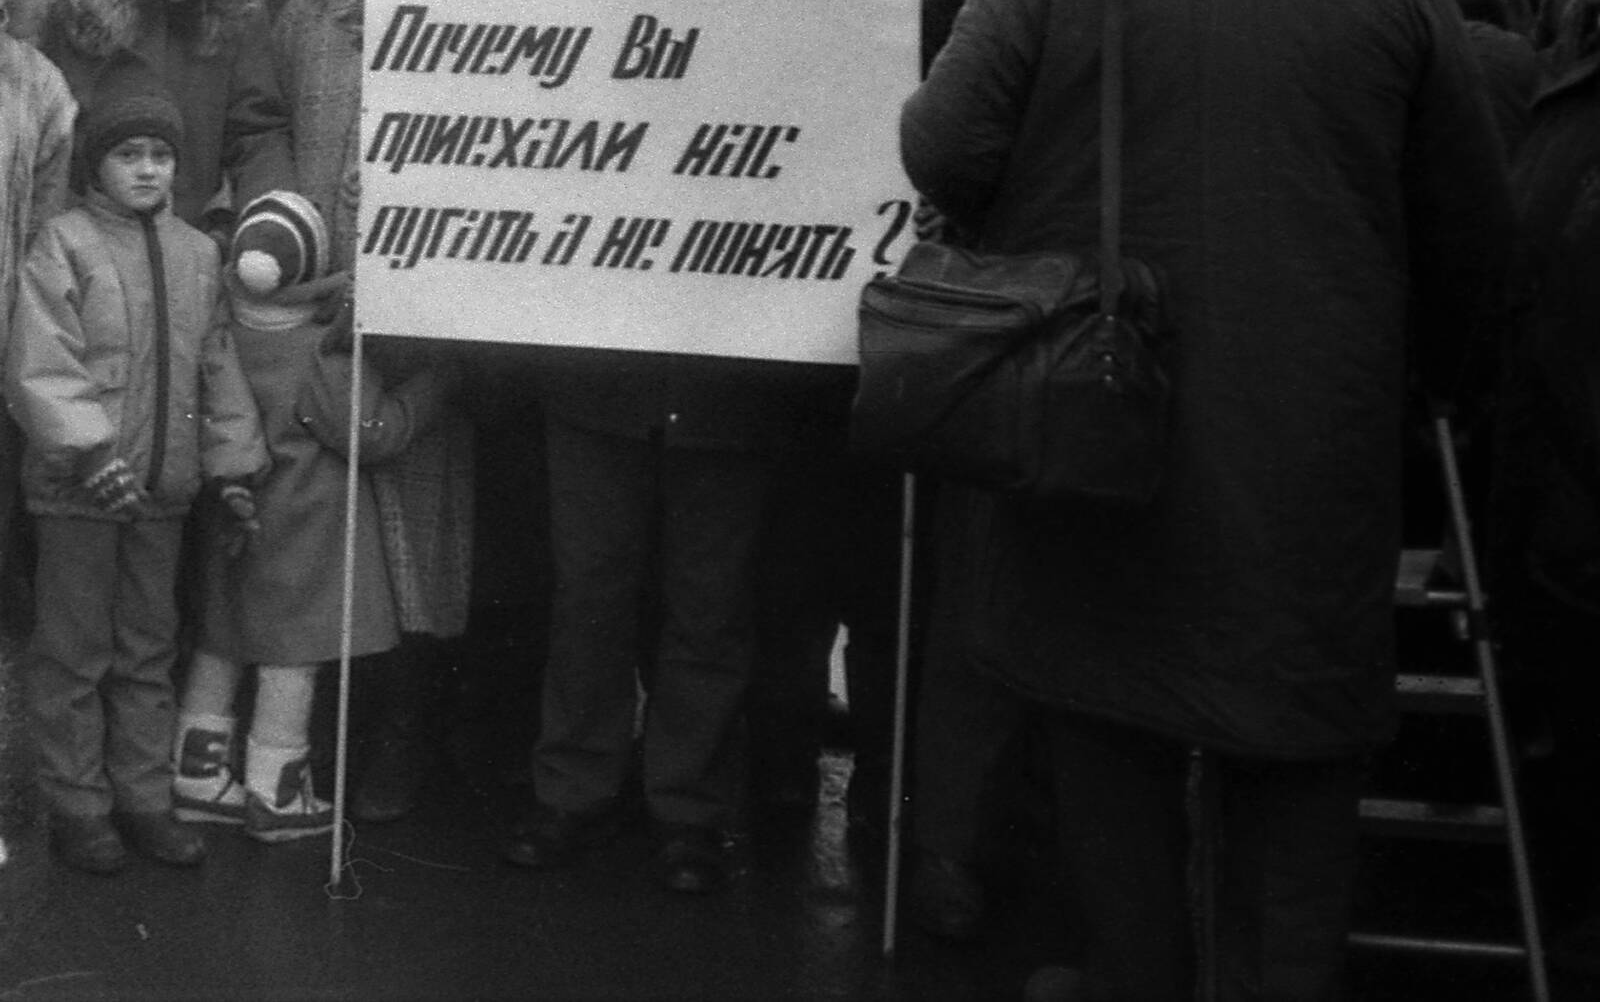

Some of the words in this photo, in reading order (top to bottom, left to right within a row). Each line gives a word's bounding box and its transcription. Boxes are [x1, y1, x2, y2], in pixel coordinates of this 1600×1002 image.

[370, 5, 593, 89] Почему
[611, 13, 700, 80] Вы
[366, 111, 650, 174] приехали
[673, 122, 800, 179] нас
[362, 205, 539, 270] пугать
[541, 213, 592, 266] а
[592, 216, 671, 271] не
